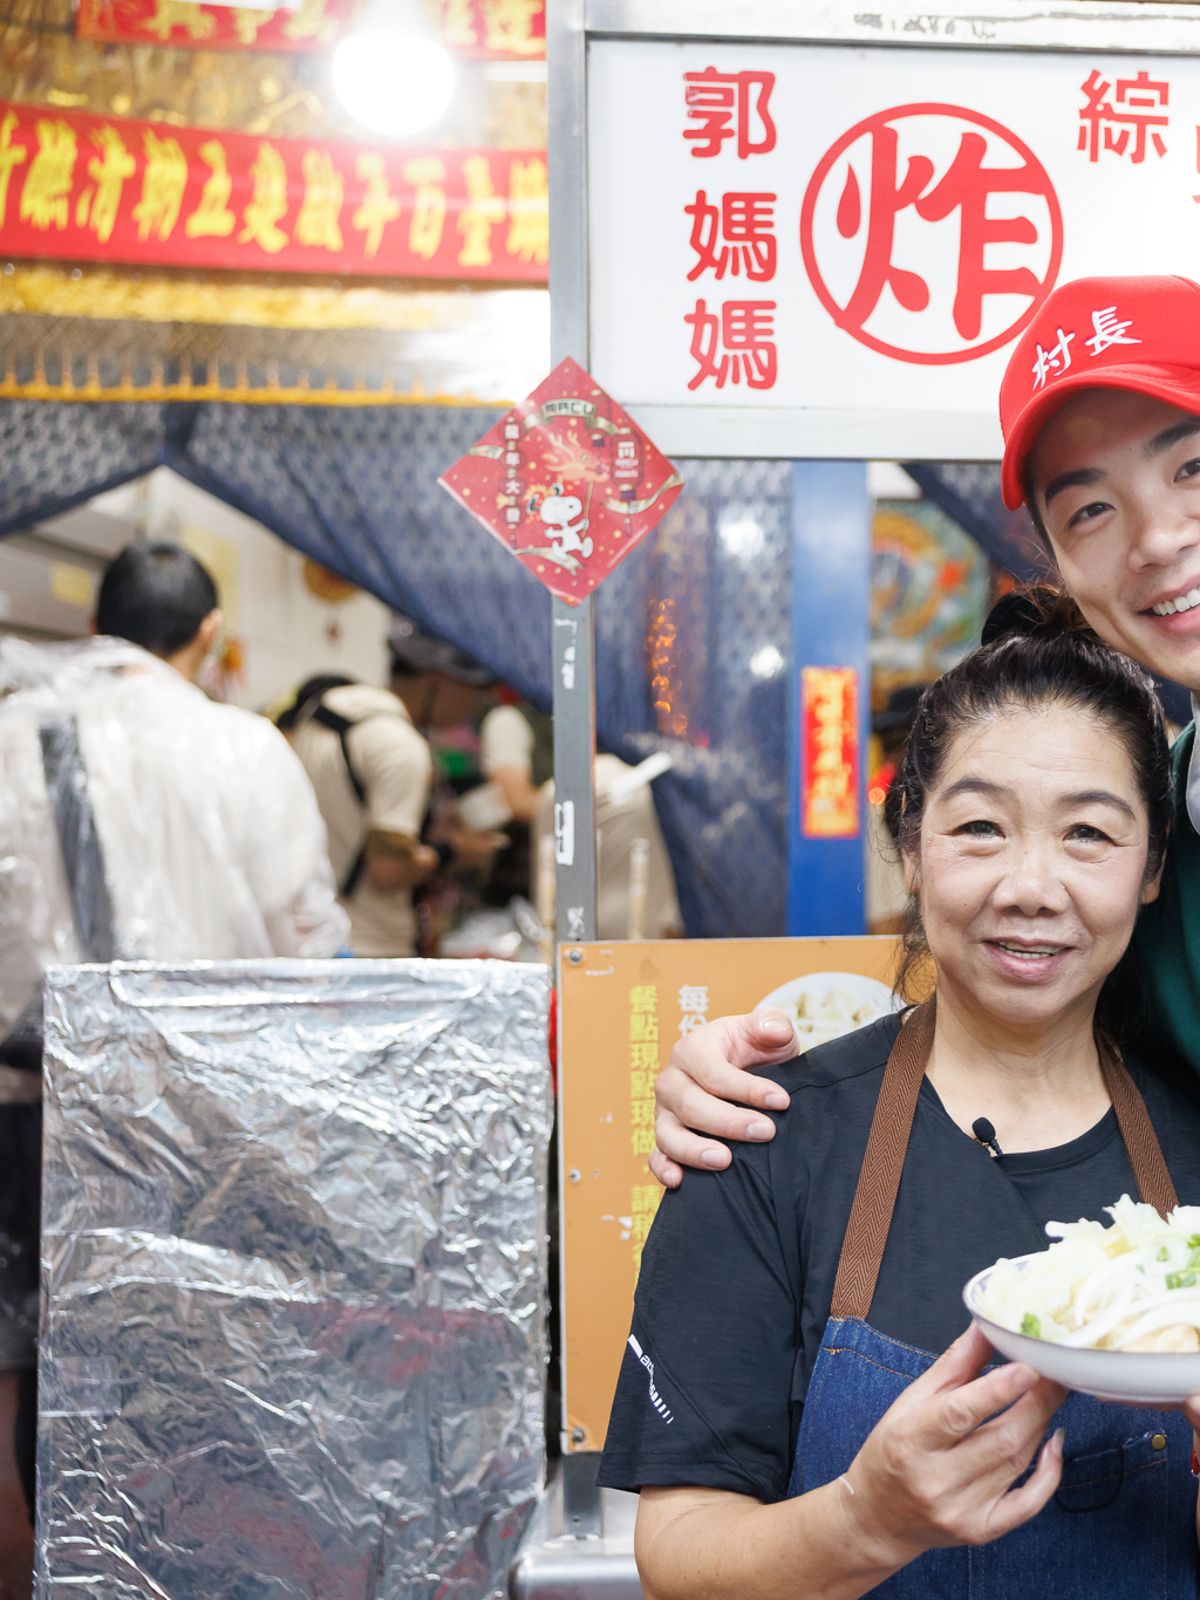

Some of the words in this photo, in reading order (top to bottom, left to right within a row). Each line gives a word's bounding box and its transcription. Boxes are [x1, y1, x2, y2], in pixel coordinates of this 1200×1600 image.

[1077, 69, 1170, 164] 綜
[683, 66, 777, 391] 郭媽媽
[836, 124, 1042, 342] 炸
[1031, 306, 1143, 390] 村長
